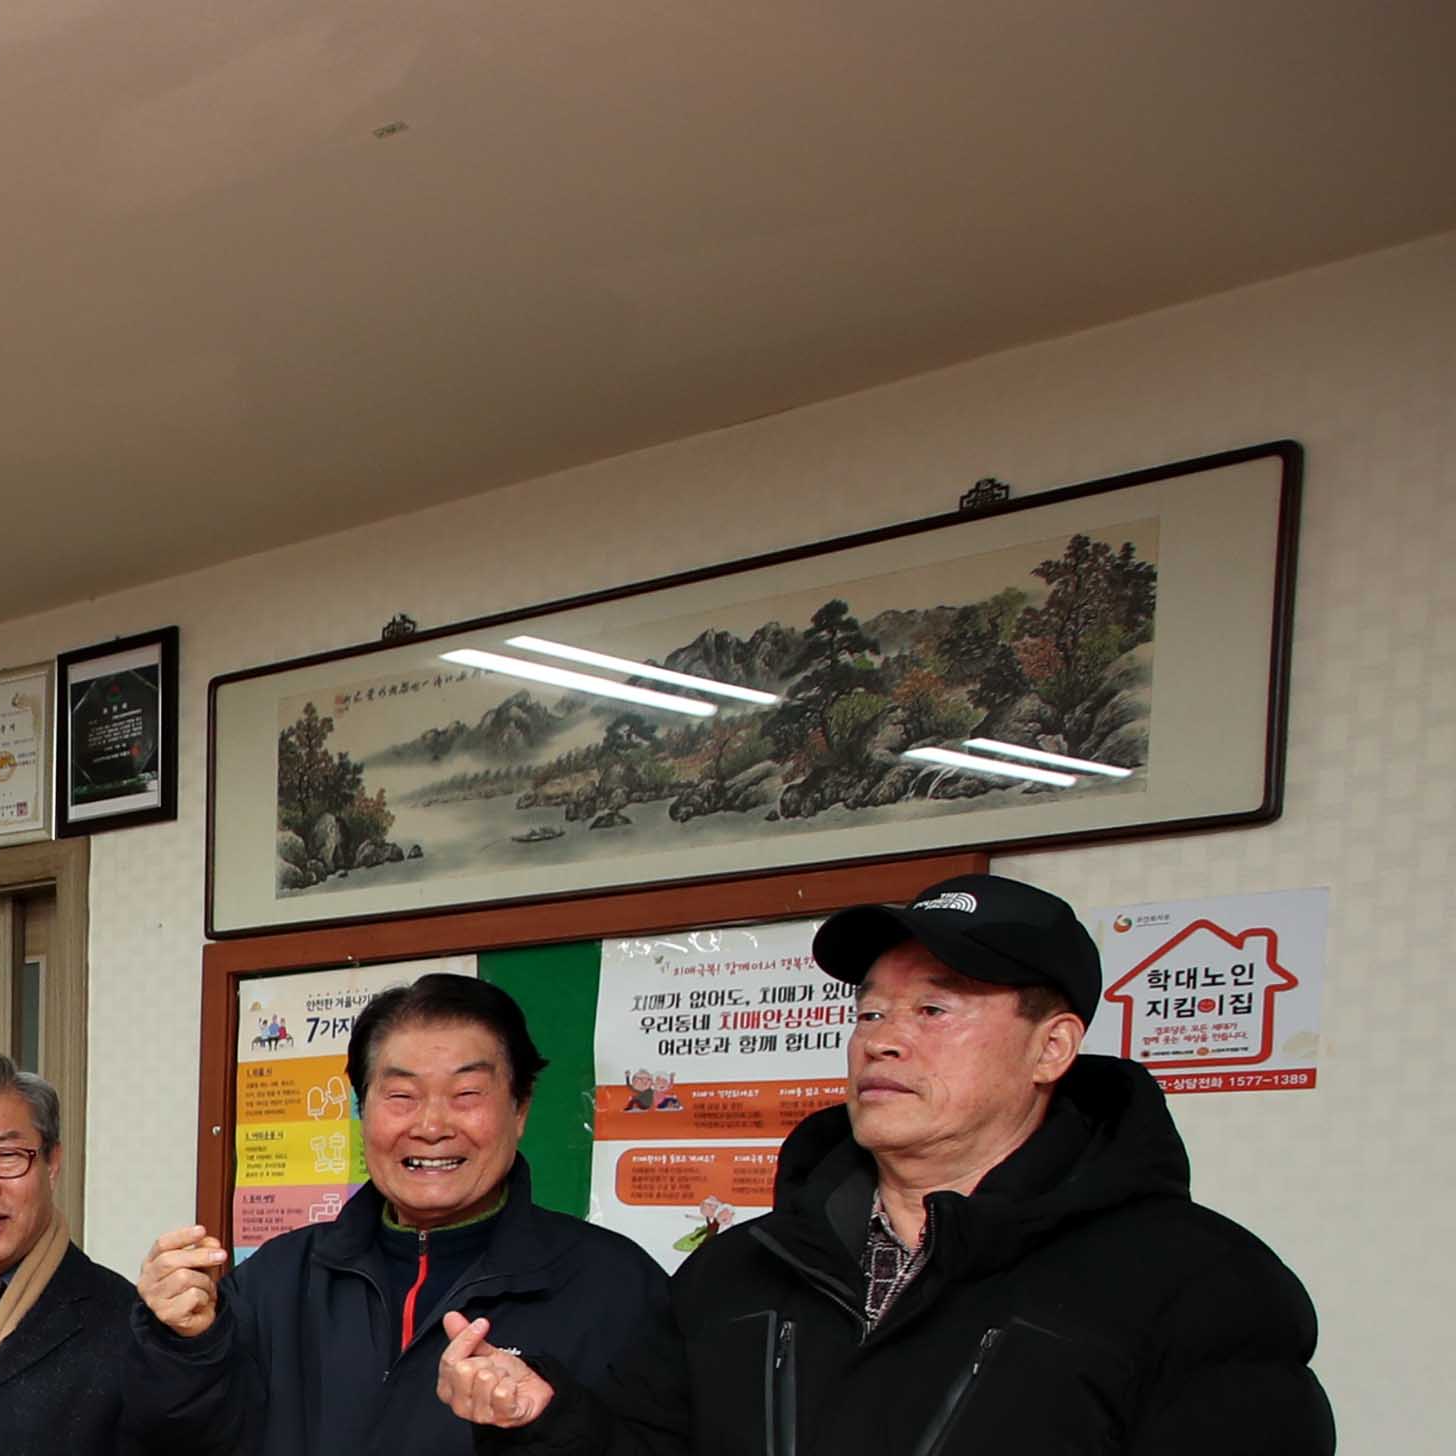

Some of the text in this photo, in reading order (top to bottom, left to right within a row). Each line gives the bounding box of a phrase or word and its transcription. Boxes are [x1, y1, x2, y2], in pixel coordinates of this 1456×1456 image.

[1147, 963, 1255, 992] 학대노인
[632, 993, 682, 1012] 치매가
[689, 990, 751, 1009] 없어도,
[758, 985, 814, 1005] 치매가
[1145, 992, 1253, 1020] 지킴이집
[640, 1014, 711, 1034] 우리동네
[658, 1031, 842, 1056] 여러분과 함께 합니다
[1229, 1074, 1308, 1087] 1577-1389
